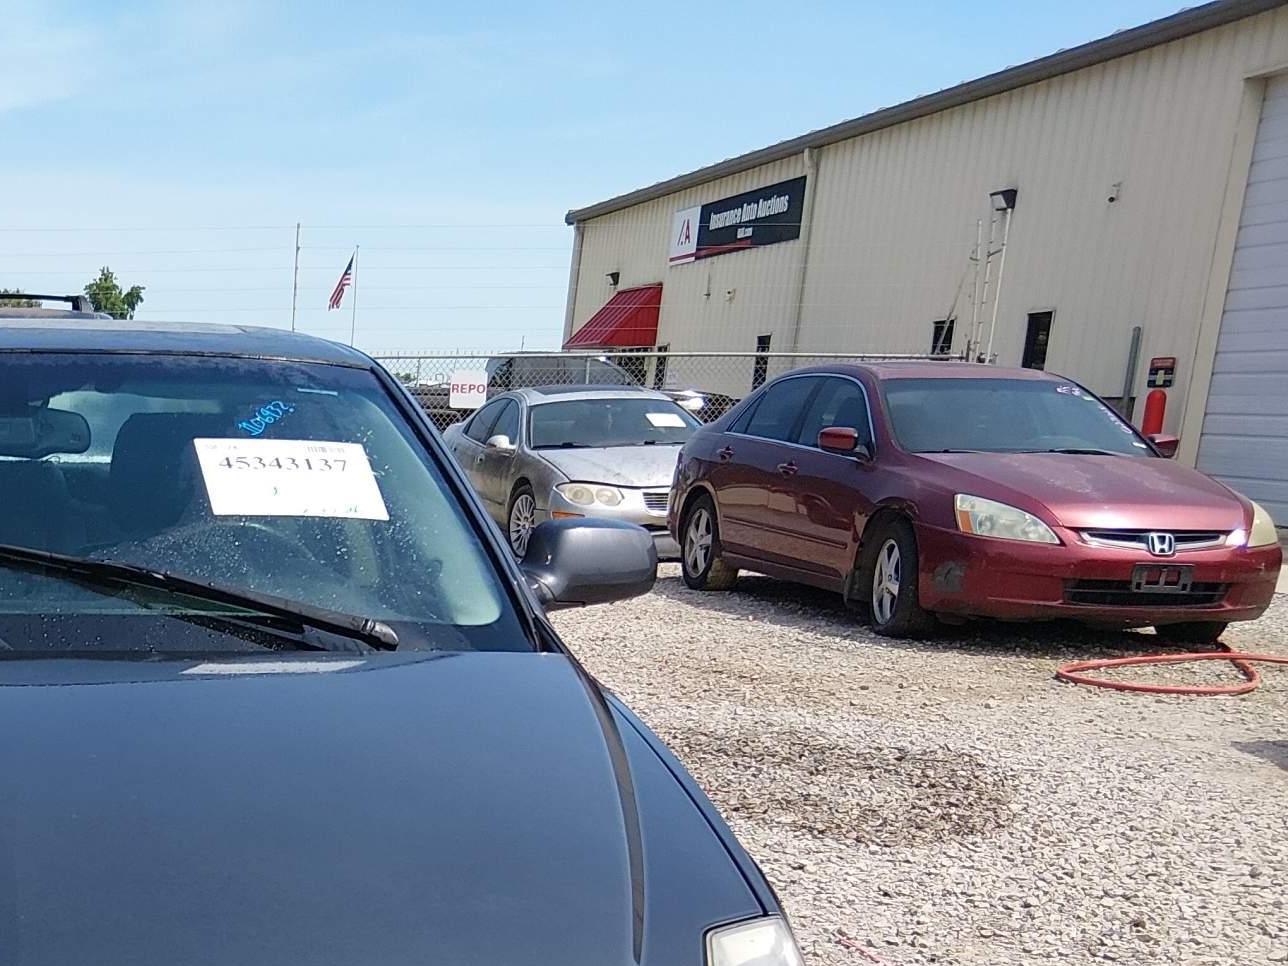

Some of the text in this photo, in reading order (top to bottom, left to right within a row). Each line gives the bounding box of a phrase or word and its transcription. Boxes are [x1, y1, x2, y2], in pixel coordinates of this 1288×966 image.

[709, 195, 789, 231] Insurance Auto Auctions
[451, 383, 486, 394] REPO
[218, 455, 347, 473] 45343137
